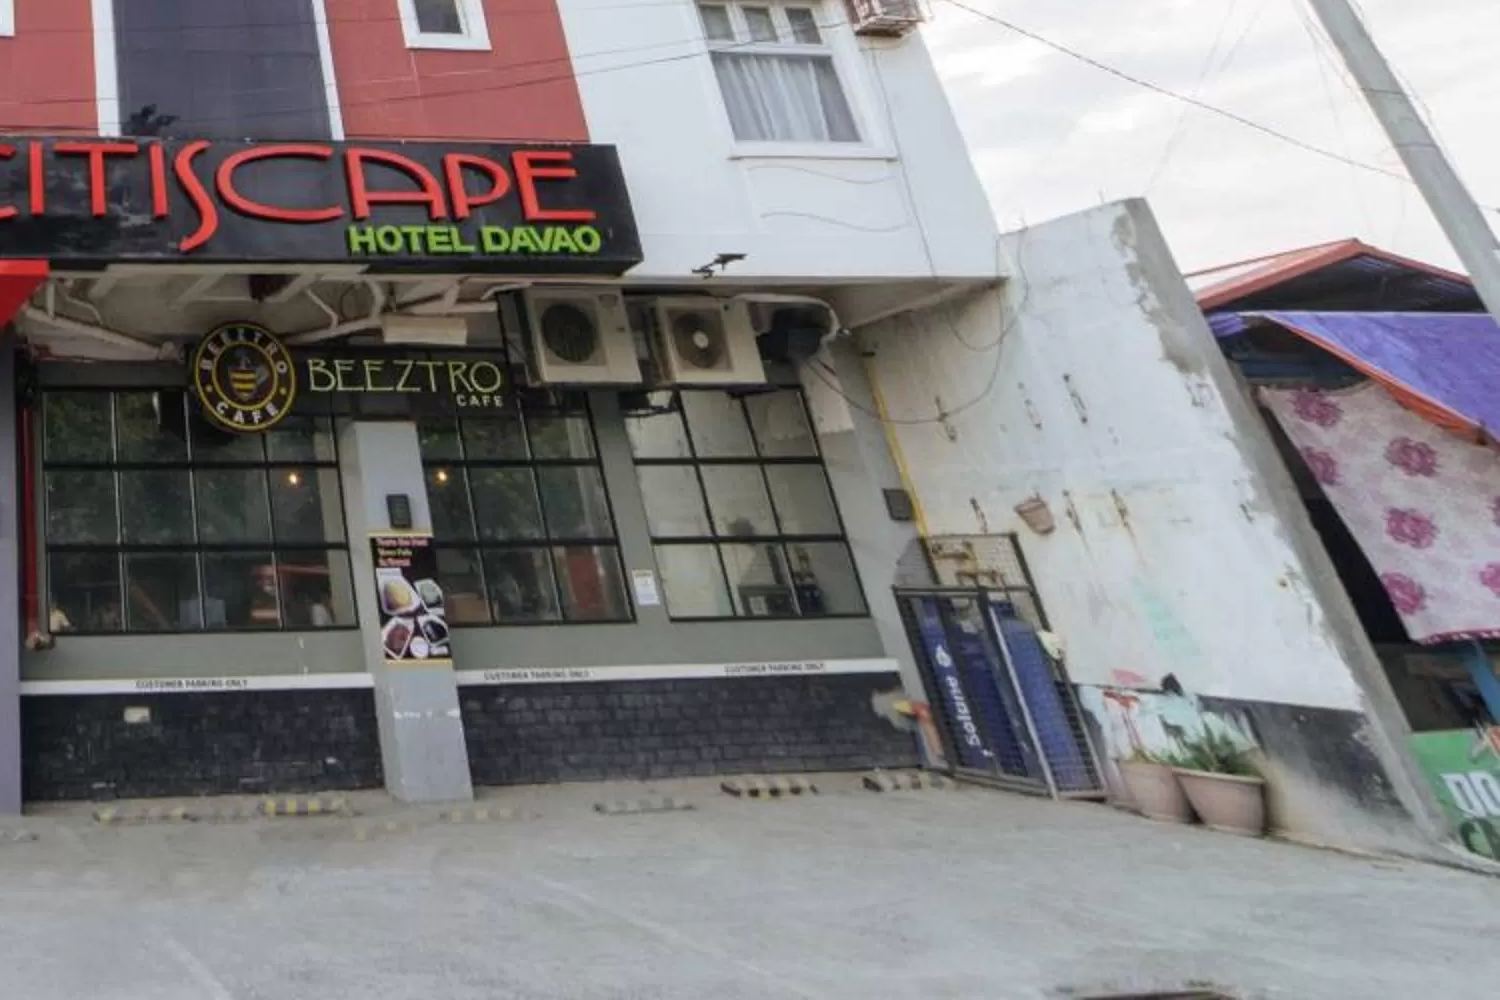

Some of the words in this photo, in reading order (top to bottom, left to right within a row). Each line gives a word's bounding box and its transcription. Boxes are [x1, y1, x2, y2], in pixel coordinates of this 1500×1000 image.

[351, 225, 475, 253] HOTEL
[482, 225, 601, 252] DAVAO
[307, 359, 501, 393] BEEZTRO
[216, 401, 279, 425] CAFE
[456, 395, 503, 408] CAFE
